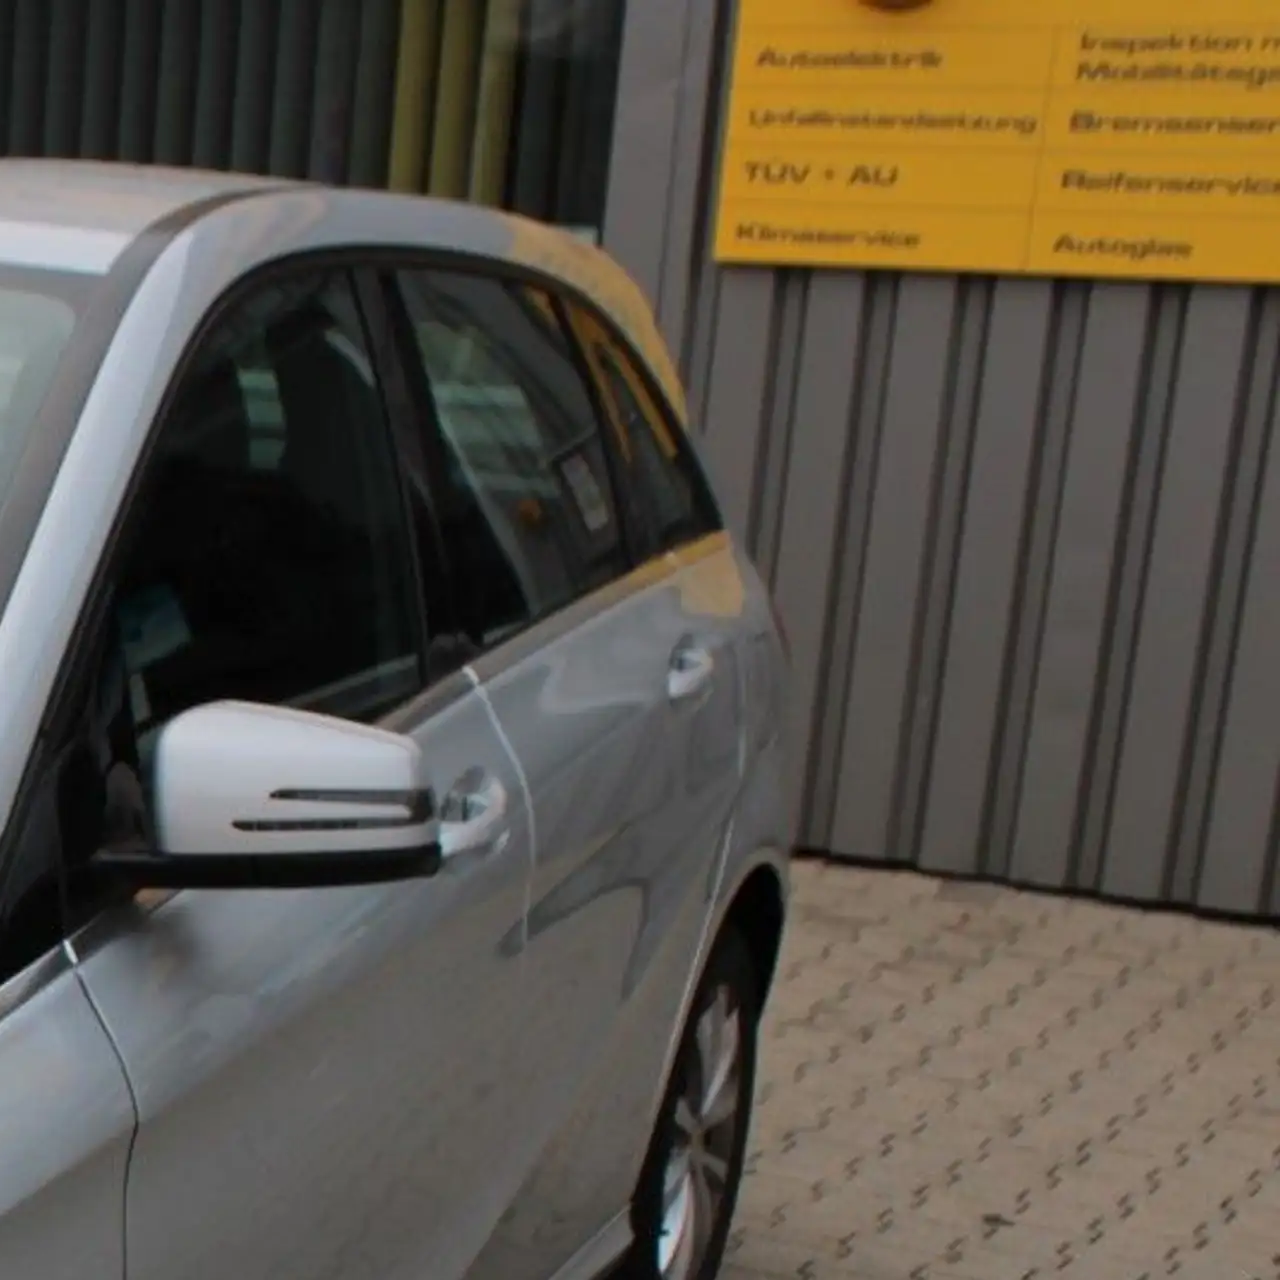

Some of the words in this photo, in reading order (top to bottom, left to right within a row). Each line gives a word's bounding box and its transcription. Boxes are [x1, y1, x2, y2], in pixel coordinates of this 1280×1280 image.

[744, 158, 811, 185] TÜV
[848, 163, 900, 187] AU
[734, 222, 922, 249] Klimaservice
[1052, 231, 1195, 260] Autoglas
